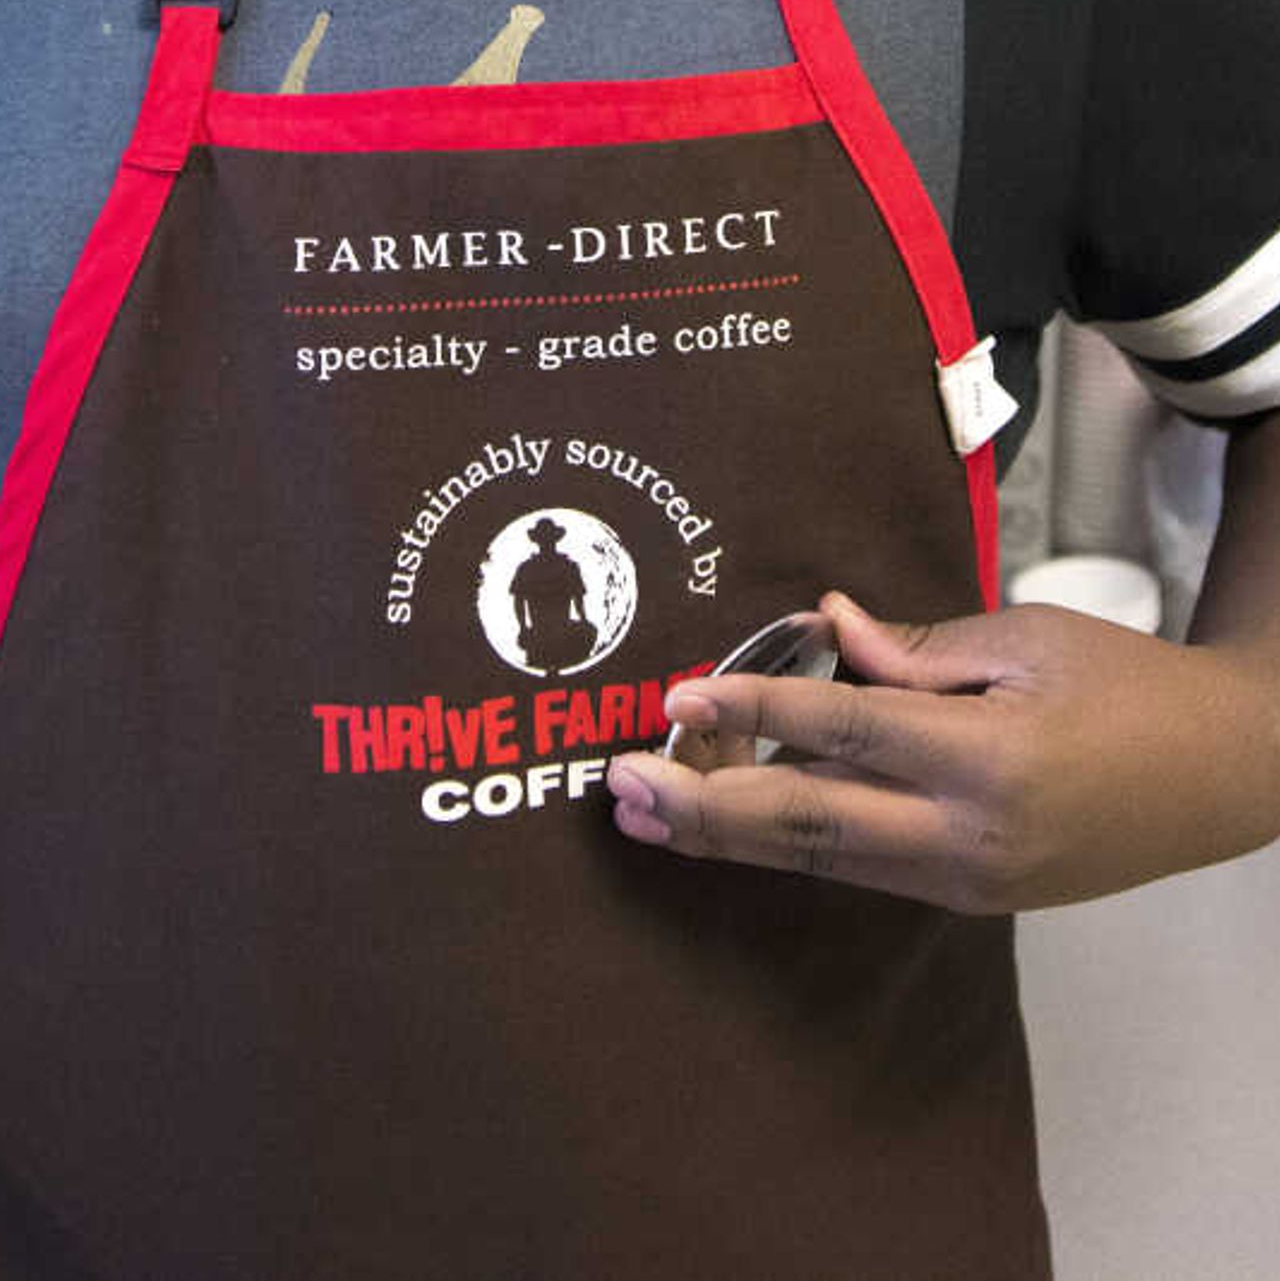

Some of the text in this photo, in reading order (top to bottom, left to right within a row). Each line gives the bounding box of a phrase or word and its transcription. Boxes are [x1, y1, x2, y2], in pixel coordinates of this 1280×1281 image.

[295, 334, 488, 381] specialty
[537, 325, 658, 371] grade
[673, 312, 793, 355] coffee
[387, 432, 724, 626] sustainably sourced by
[534, 660, 716, 756] FARM
[420, 758, 611, 825] COFF
